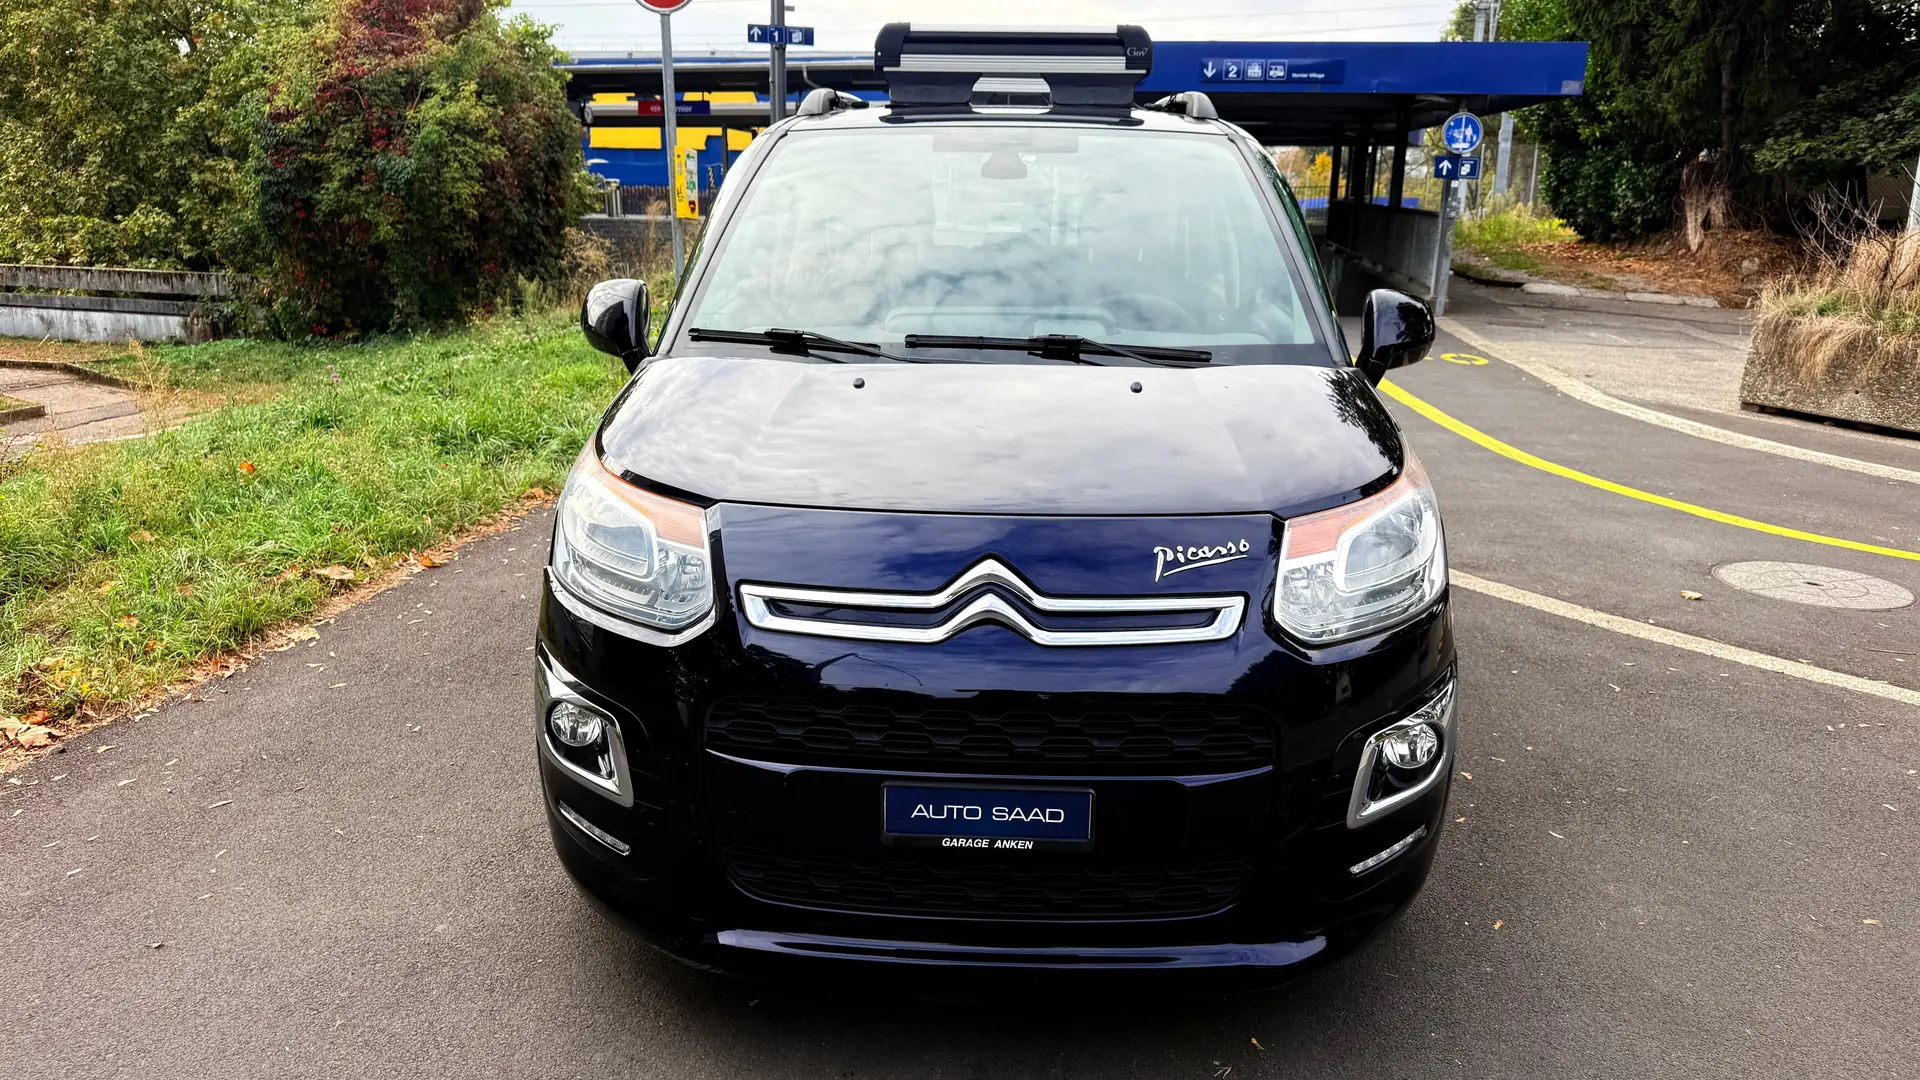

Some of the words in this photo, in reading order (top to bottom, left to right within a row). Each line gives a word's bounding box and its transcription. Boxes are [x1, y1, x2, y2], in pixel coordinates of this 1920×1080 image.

[773, 30, 779, 42] 1
[1228, 65, 1238, 78] 2
[911, 804, 982, 820] AUTO
[992, 806, 1065, 823] SAAD
[941, 837, 990, 848] GARAGE
[993, 839, 1034, 850] ANKEN
